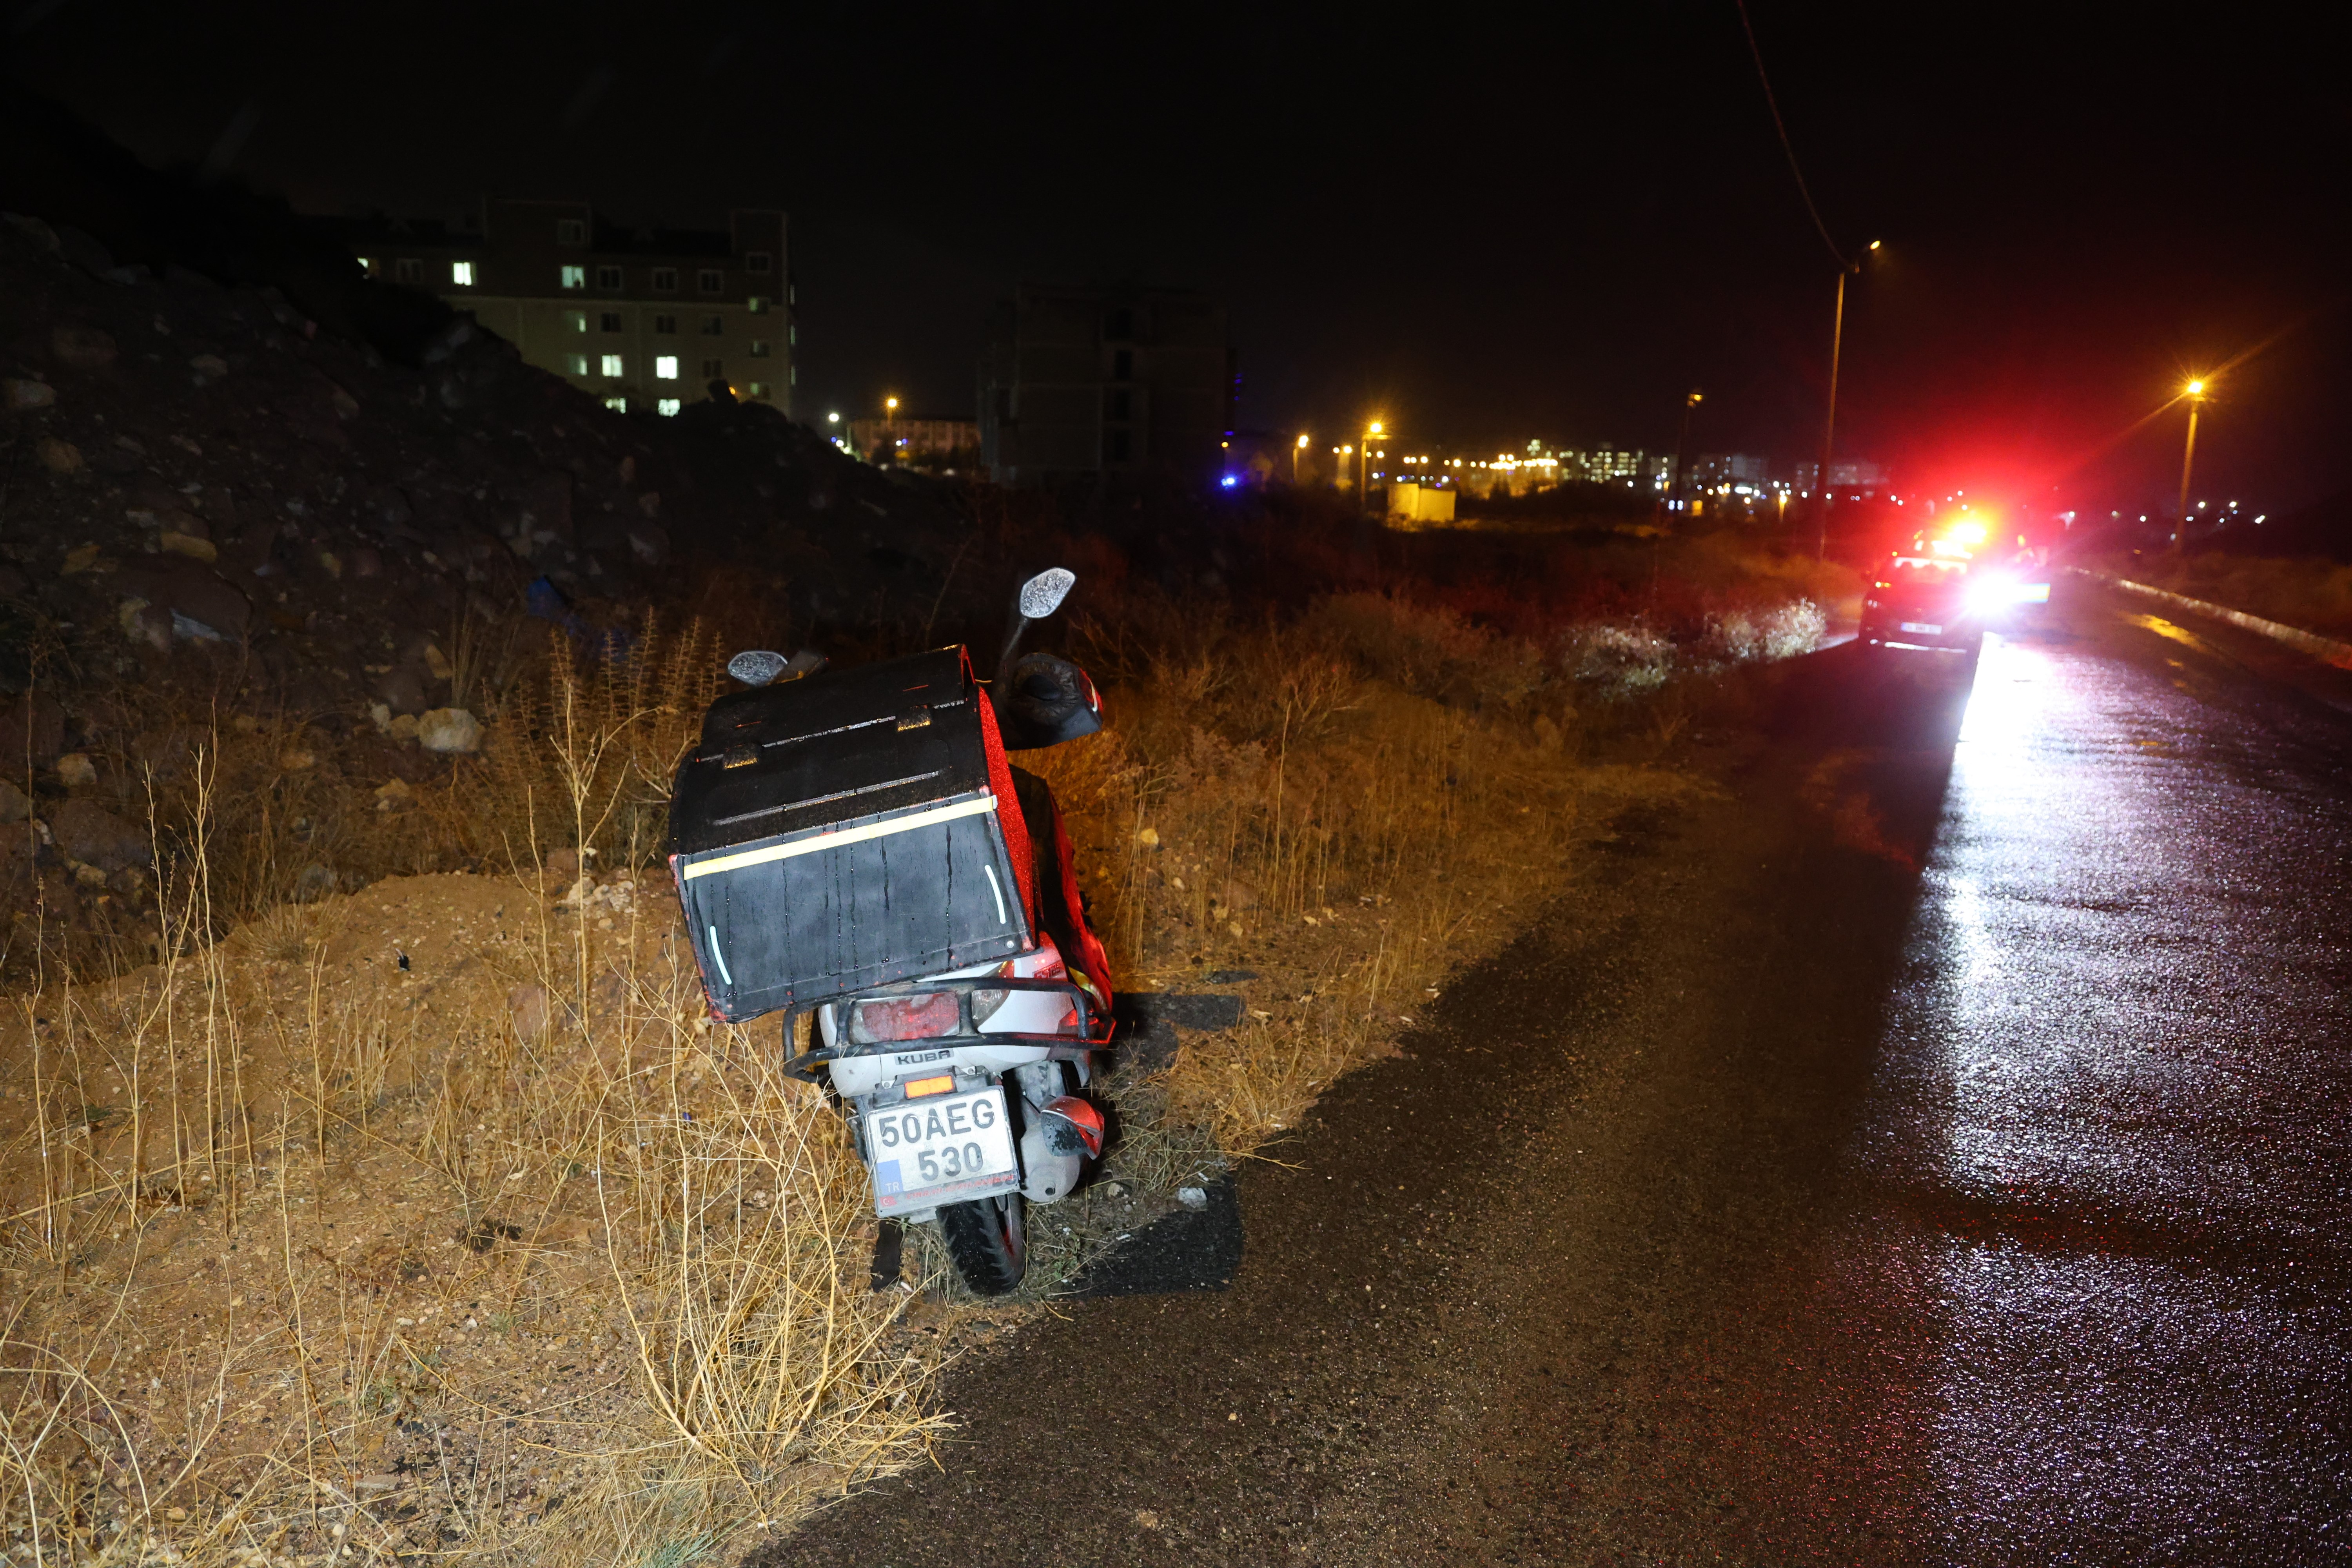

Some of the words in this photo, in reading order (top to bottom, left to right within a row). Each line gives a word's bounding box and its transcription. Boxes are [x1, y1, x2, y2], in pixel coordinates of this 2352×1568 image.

[897, 1050, 951, 1065] KUBA
[879, 1099, 995, 1147] 50AEG
[918, 1142, 983, 1181] 530
[885, 1181, 900, 1192] TR
